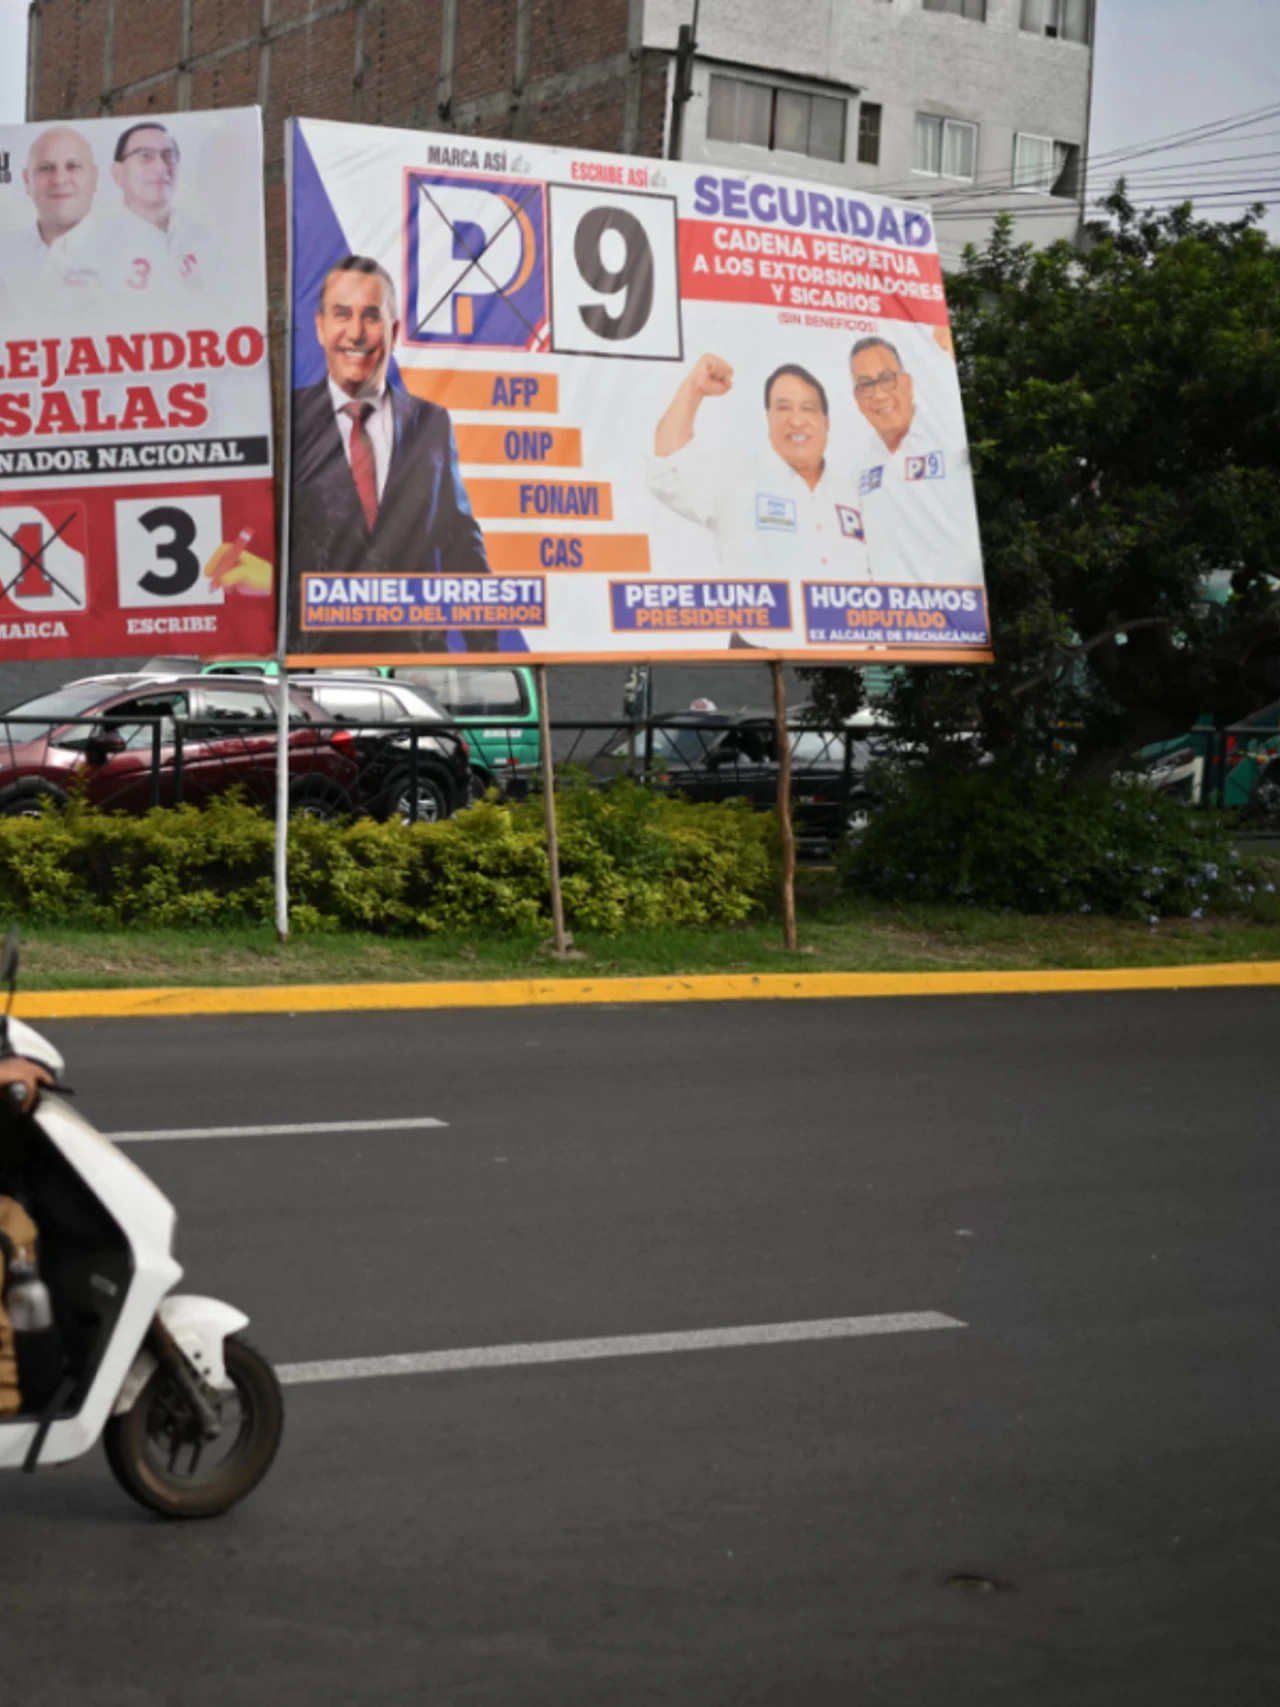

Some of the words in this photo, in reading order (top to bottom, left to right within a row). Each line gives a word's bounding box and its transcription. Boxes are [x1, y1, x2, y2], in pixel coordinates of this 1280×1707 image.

[428, 146, 479, 169] MARCA
[483, 150, 507, 171] ASÍ
[571, 161, 623, 184] ESCRIBE
[628, 166, 648, 186] ASÍ
[694, 175, 932, 248] SEGURIDAD
[713, 227, 808, 259] CADENA
[813, 239, 920, 276] PERPETUA
[126, 257, 151, 289] 3
[574, 205, 654, 341] 9
[693, 255, 709, 273] A
[715, 257, 754, 276] LOS
[759, 261, 944, 301] EXTORSIONADORES
[771, 284, 785, 302] Y
[790, 286, 881, 313] SICARIOS
[492, 376, 539, 406] AFP
[97, 442, 244, 468] NACIONAL
[504, 431, 553, 460] ONP
[520, 484, 599, 515] FONAVI
[13, 523, 53, 598] 1
[138, 506, 200, 596] 3
[540, 538, 583, 567] CAS
[307, 580, 415, 603] DANIEL
[422, 580, 542, 603] URRESTI
[625, 584, 695, 607] PEPE
[702, 585, 775, 607] LUNA
[812, 587, 882, 608] HUGO
[889, 588, 977, 611] RAMOS
[127, 616, 217, 634] ESCRIBE
[308, 606, 405, 622] MINISTRO
[410, 606, 446, 622] DEL
[453, 606, 542, 622] INTERIOR
[636, 608, 769, 627] PRESIDENTE
[846, 609, 947, 628] DIPUTADO
[810, 629, 827, 640] EX
[830, 629, 883, 641] ALCALDE
[887, 630, 902, 641] DE
